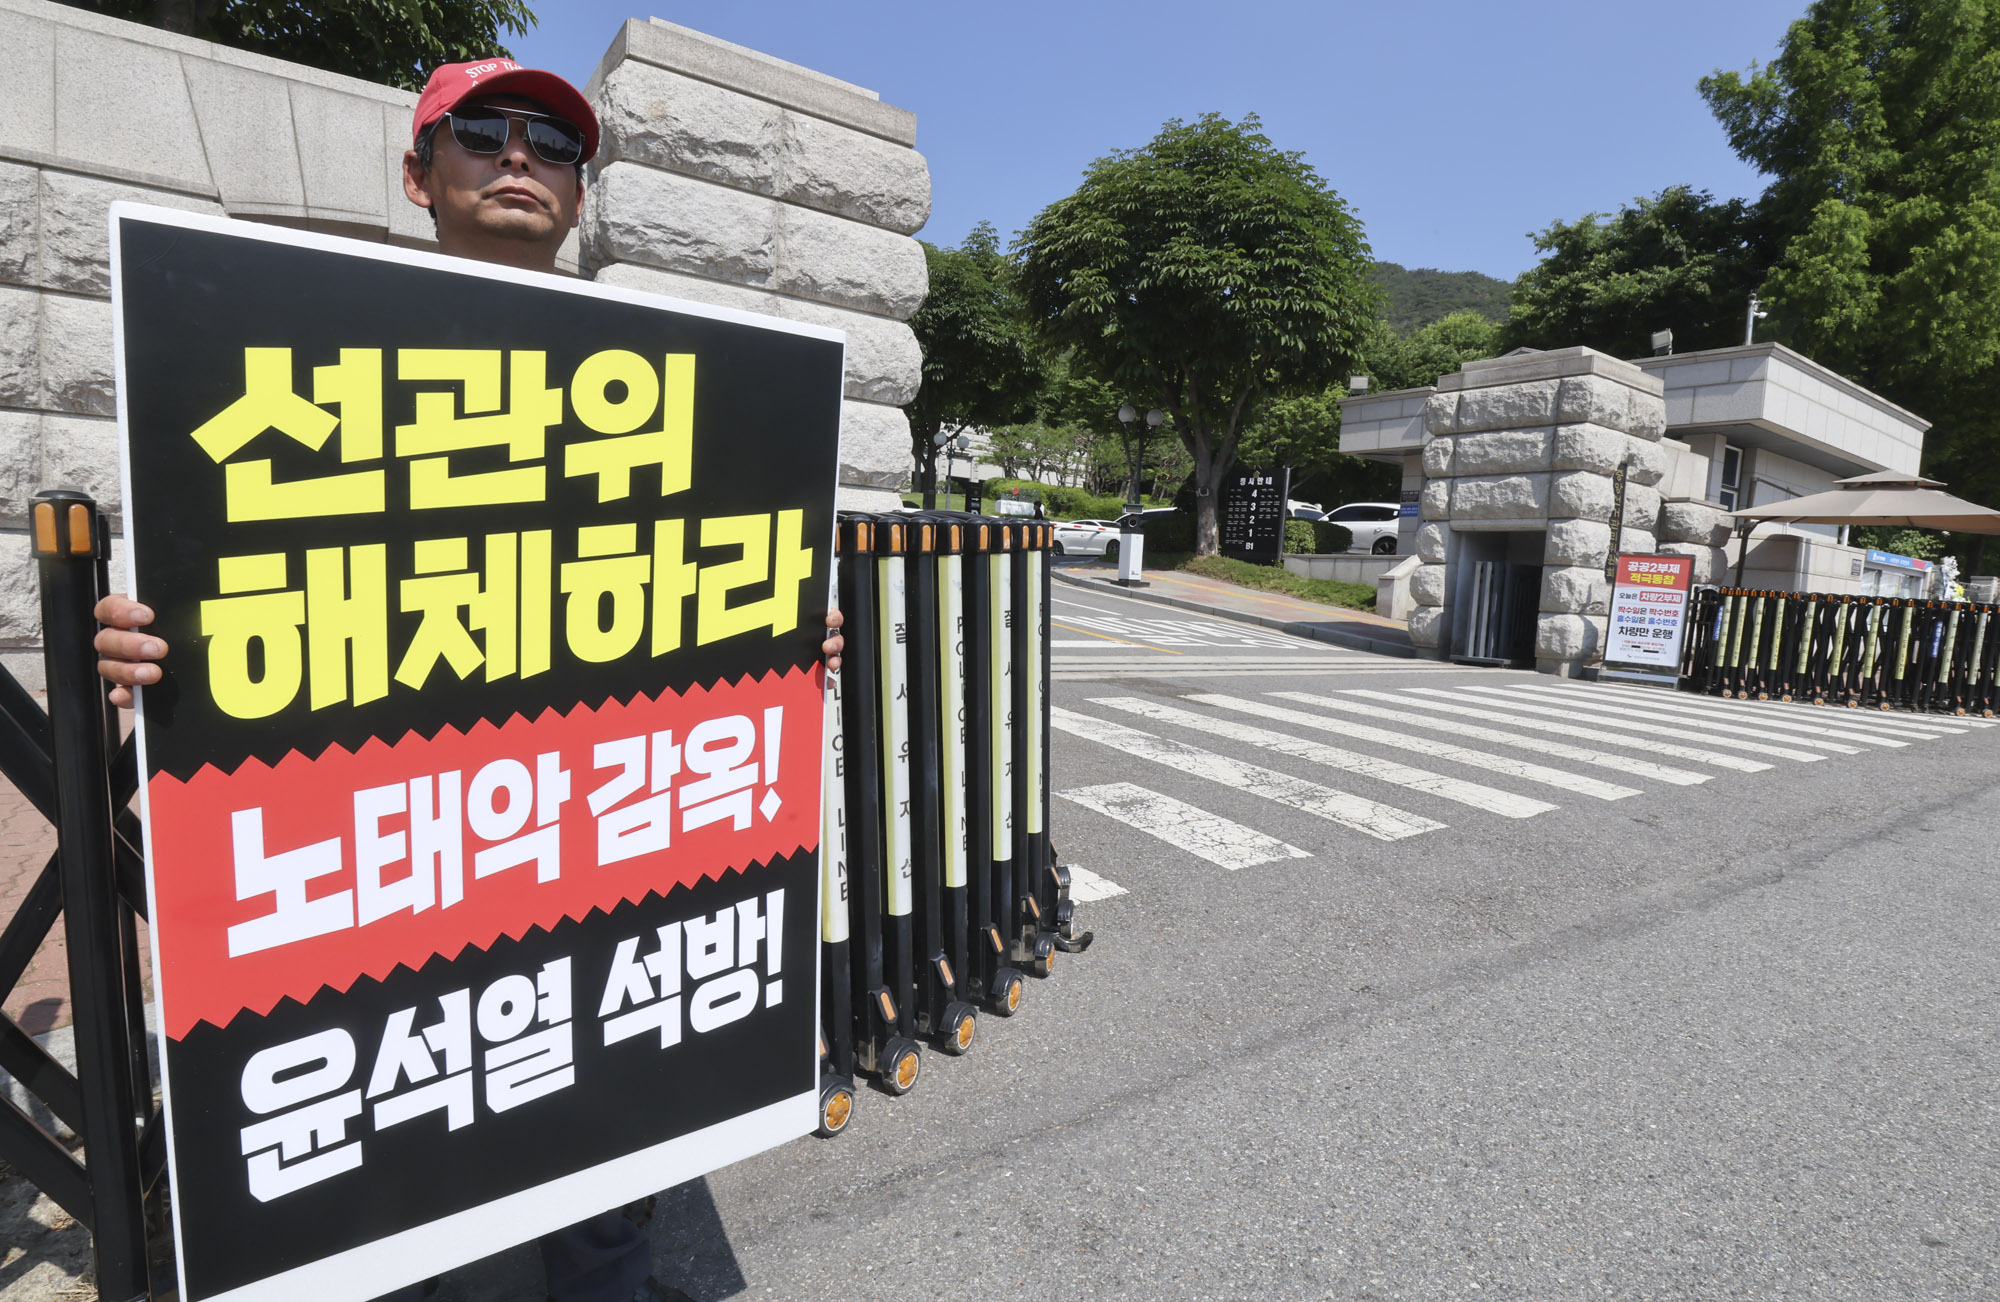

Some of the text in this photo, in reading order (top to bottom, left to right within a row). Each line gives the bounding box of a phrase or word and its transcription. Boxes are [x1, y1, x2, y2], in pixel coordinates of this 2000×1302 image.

[465, 62, 498, 78] STOP
[190, 347, 696, 522] 선관위
[1252, 489, 1258, 498] 4
[1250, 502, 1256, 511] 3
[1249, 515, 1255, 524] 2
[1248, 528, 1253, 537] 1
[1245, 542, 1254, 550] B1
[1627, 561, 1681, 574] 공공2부제
[1630, 572, 1675, 585] 적극동참
[1641, 592, 1682, 603] 차량2부제
[200, 508, 812, 719] 해체하라
[1618, 625, 1673, 640] 차량만 운행
[227, 705, 784, 958] 노태악 감옥!
[240, 888, 785, 1203] 윤석열 석방!
